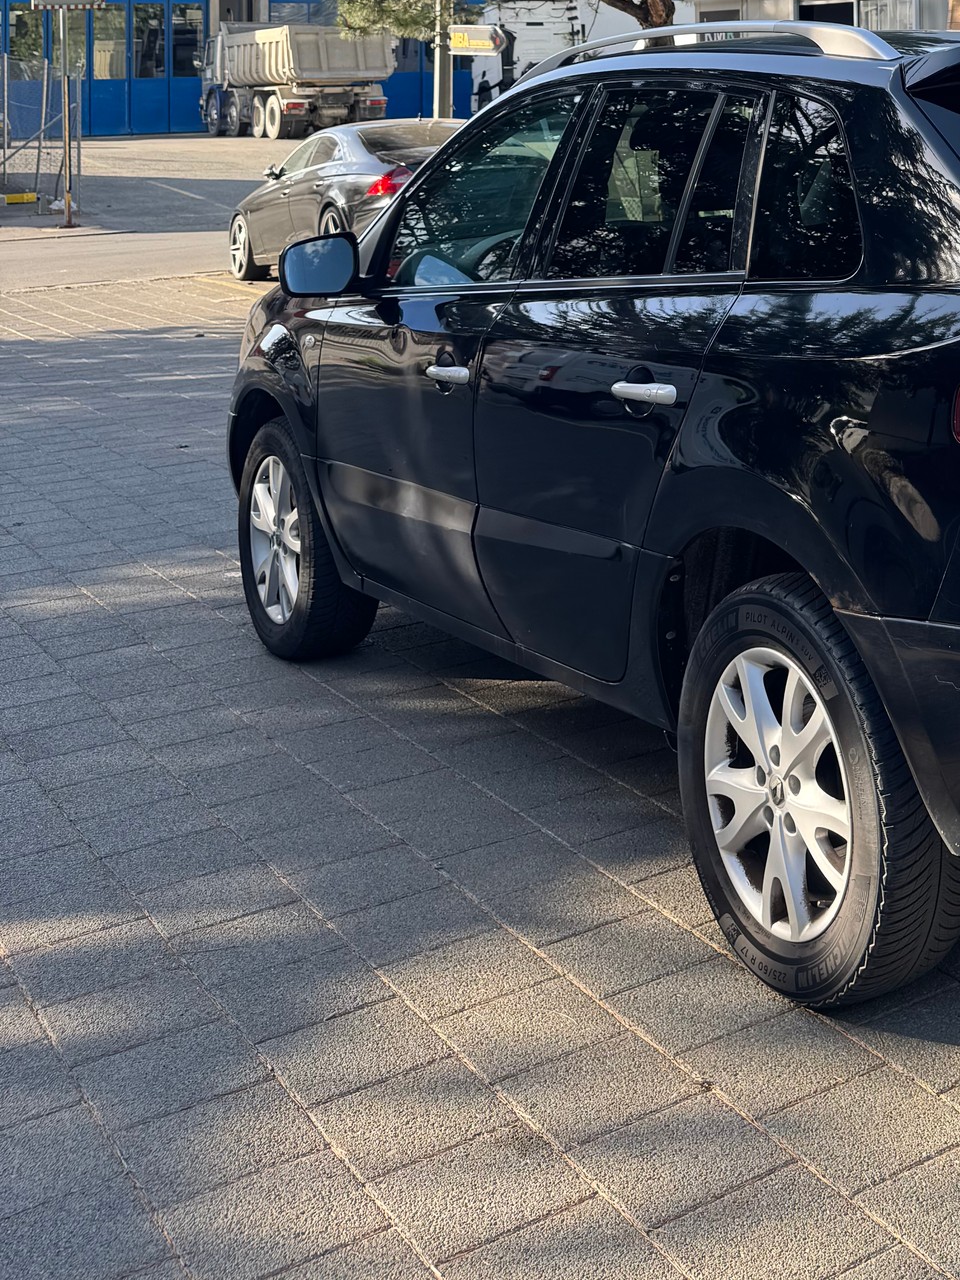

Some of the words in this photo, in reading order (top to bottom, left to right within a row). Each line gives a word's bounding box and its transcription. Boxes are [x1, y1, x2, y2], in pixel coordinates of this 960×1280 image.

[745, 611, 768, 625] PILOT
[740, 946, 749, 958] 17
[750, 954, 757, 965] R
[758, 960, 787, 984] 225/60
